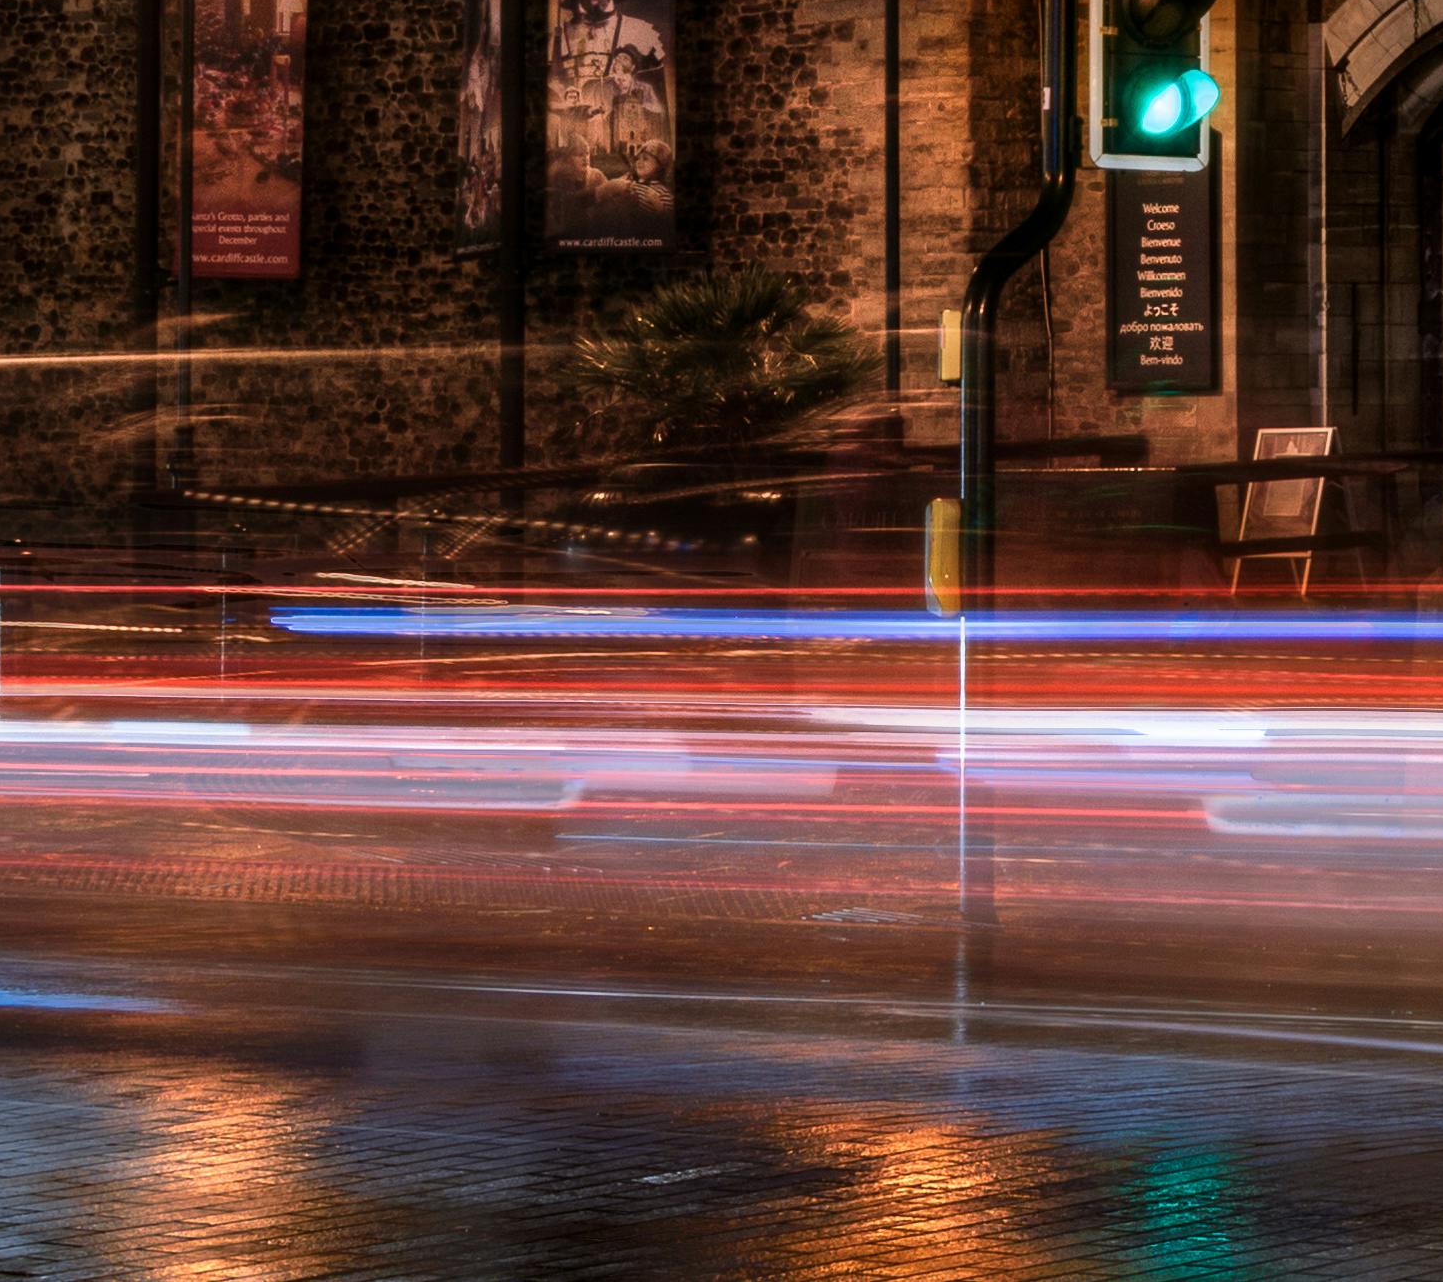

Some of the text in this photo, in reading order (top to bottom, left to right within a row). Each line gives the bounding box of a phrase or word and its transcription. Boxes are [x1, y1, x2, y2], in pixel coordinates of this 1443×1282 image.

[1142, 203, 1181, 215] Welcome
[247, 212, 273, 223] parties
[275, 213, 290, 222] and
[218, 225, 242, 234] events
[243, 224, 287, 235] throughout
[1146, 219, 1176, 231] Croeso
[218, 235, 258, 246] December
[558, 235, 663, 248] www.cardiffcastle.com
[1140, 236, 1182, 248] Bienvenue
[1139, 253, 1183, 265] Benvenuto
[1137, 270, 1187, 282] Willkommen
[1139, 287, 1183, 299] Bienvenido
[1119, 321, 1149, 335] добро
[1149, 336, 1174, 351] 欢迎
[1139, 354, 1183, 366] Bem-vindo
